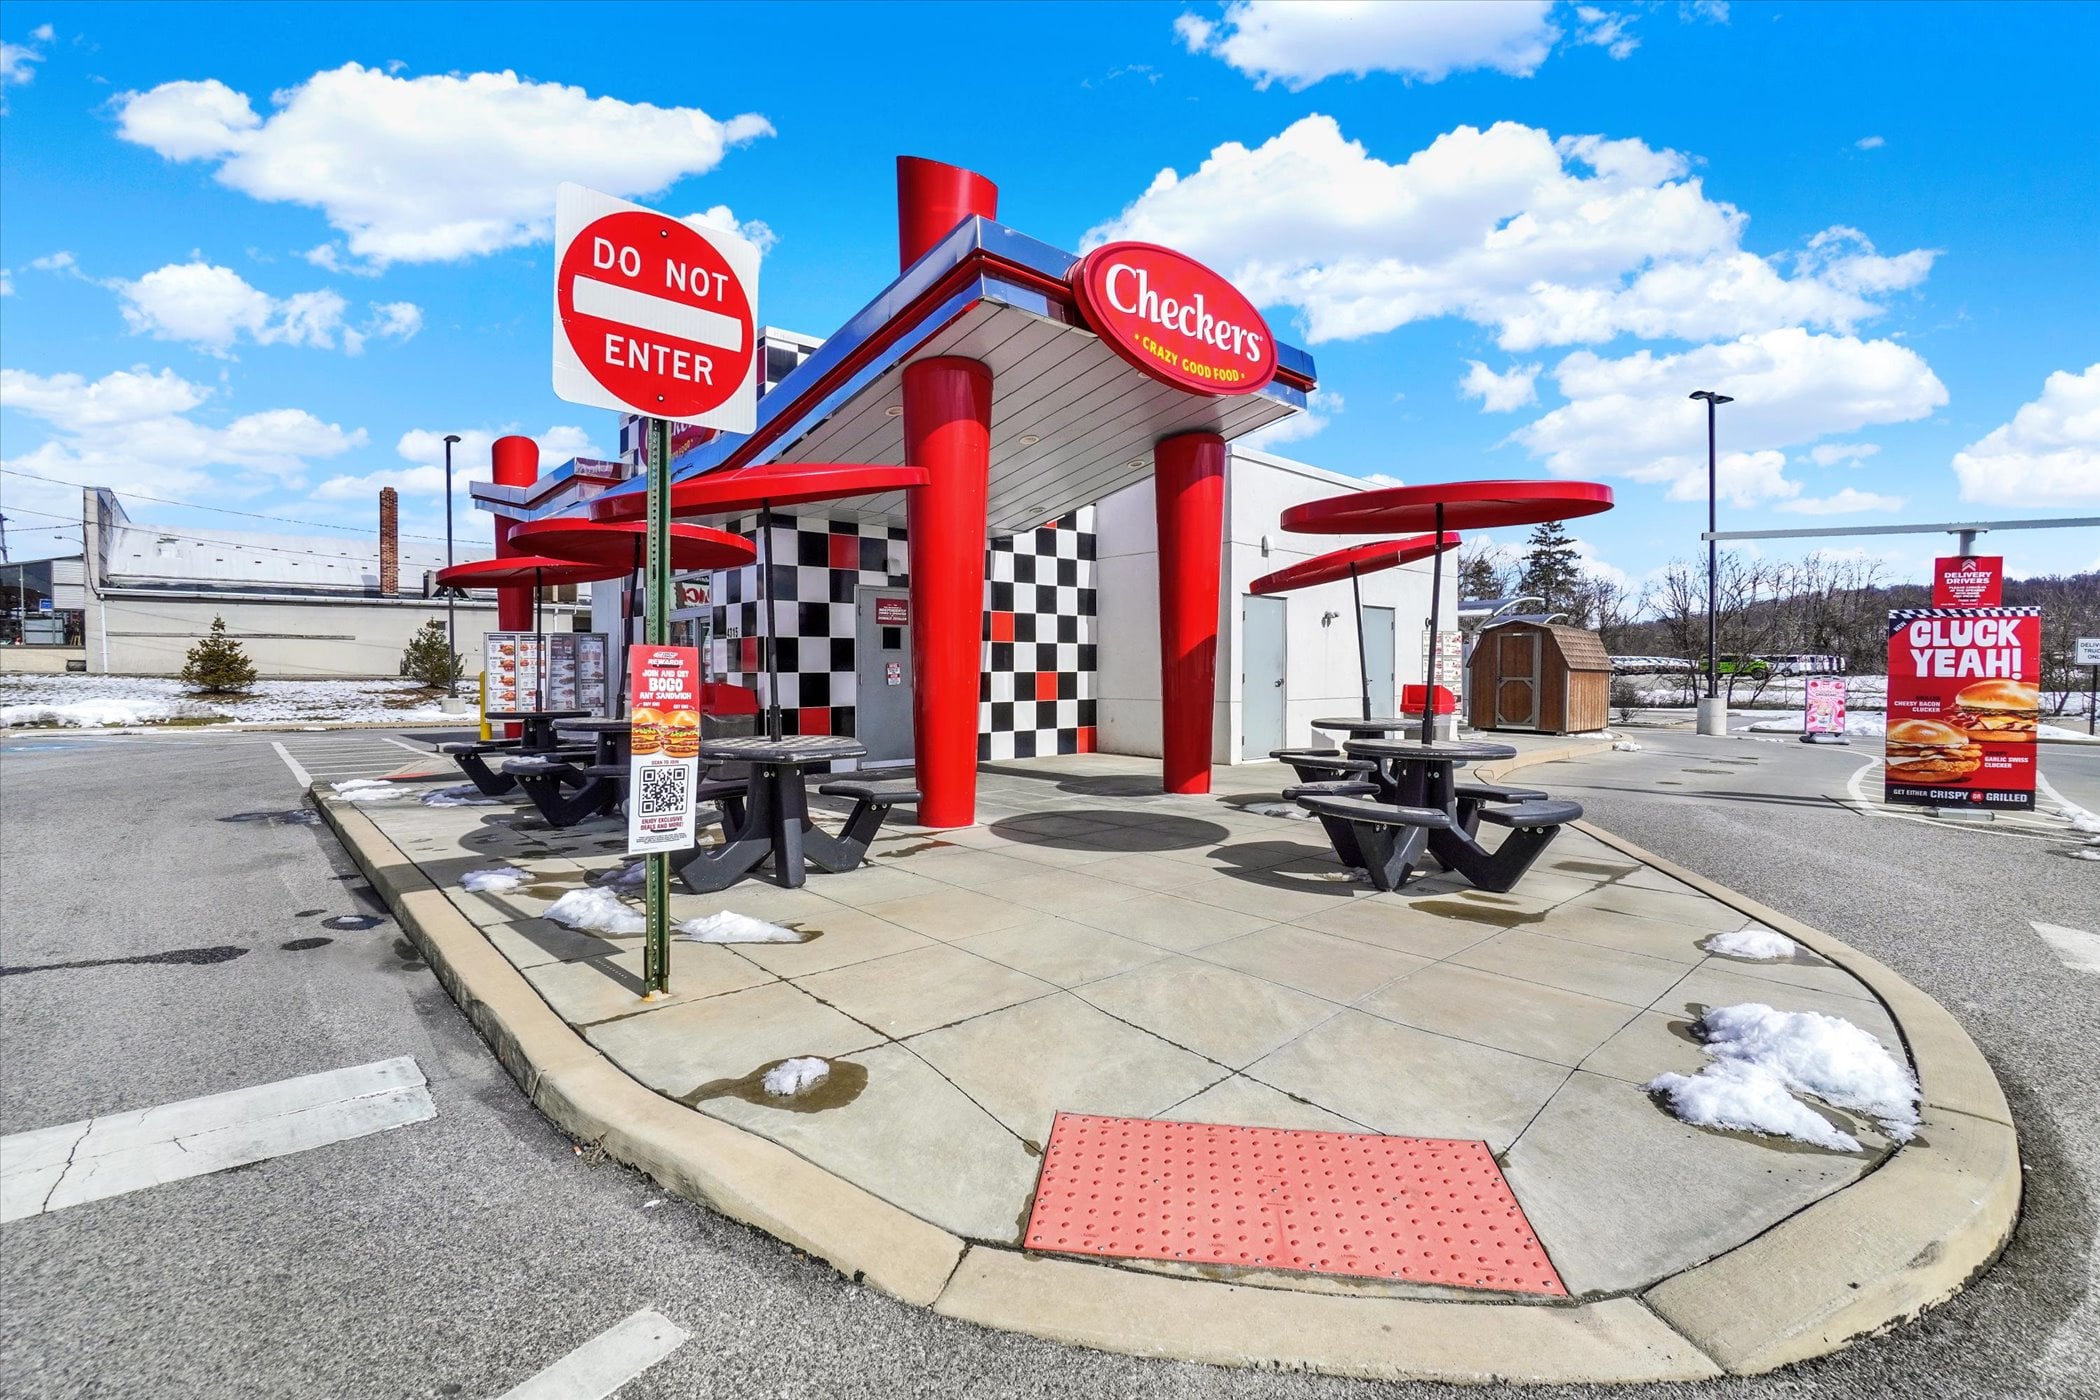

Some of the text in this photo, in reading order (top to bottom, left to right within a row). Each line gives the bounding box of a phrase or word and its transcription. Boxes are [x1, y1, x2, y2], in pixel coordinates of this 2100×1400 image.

[593, 236, 729, 302] DO NOT
[1105, 263, 1262, 362] Checkers
[605, 333, 713, 386] ENTER
[1142, 336, 1239, 383] CRAZY GOOD FOOD
[1893, 621, 1907, 633] NEW
[1910, 619, 2022, 648] CLUCK
[642, 669, 659, 677] JOIN
[677, 670, 690, 678] GET
[1910, 648, 2023, 681] YEAH!
[640, 692, 692, 700] ANY SANDWICH
[648, 678, 684, 692] BOGO
[1906, 789, 1928, 797] EITHER
[1930, 790, 1969, 800] CRISPY
[1986, 793, 2028, 803] GRILLED
